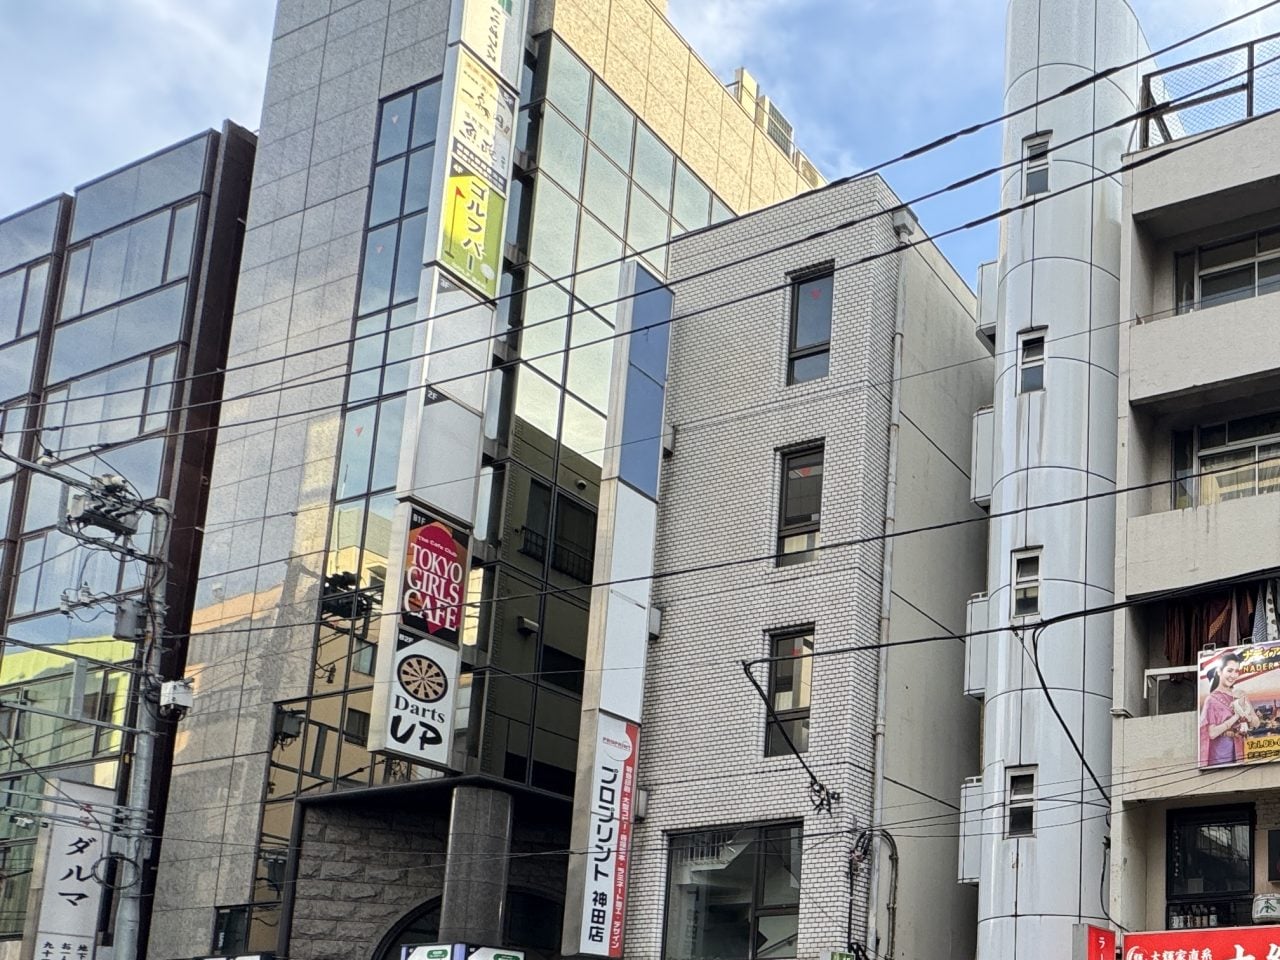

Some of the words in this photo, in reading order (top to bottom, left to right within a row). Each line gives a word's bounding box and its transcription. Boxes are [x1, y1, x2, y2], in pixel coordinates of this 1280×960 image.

[464, 181, 487, 271] ゴルフバー
[412, 513, 427, 526] B1F
[410, 542, 463, 585] TOKYO
[407, 567, 460, 606] GIRLS
[403, 589, 457, 632] CAFE
[394, 694, 446, 724] Darts
[390, 714, 443, 751] UP
[593, 766, 619, 883] プロプリント
[57, 837, 97, 907] ダルマ
[588, 890, 608, 943] 神田店
